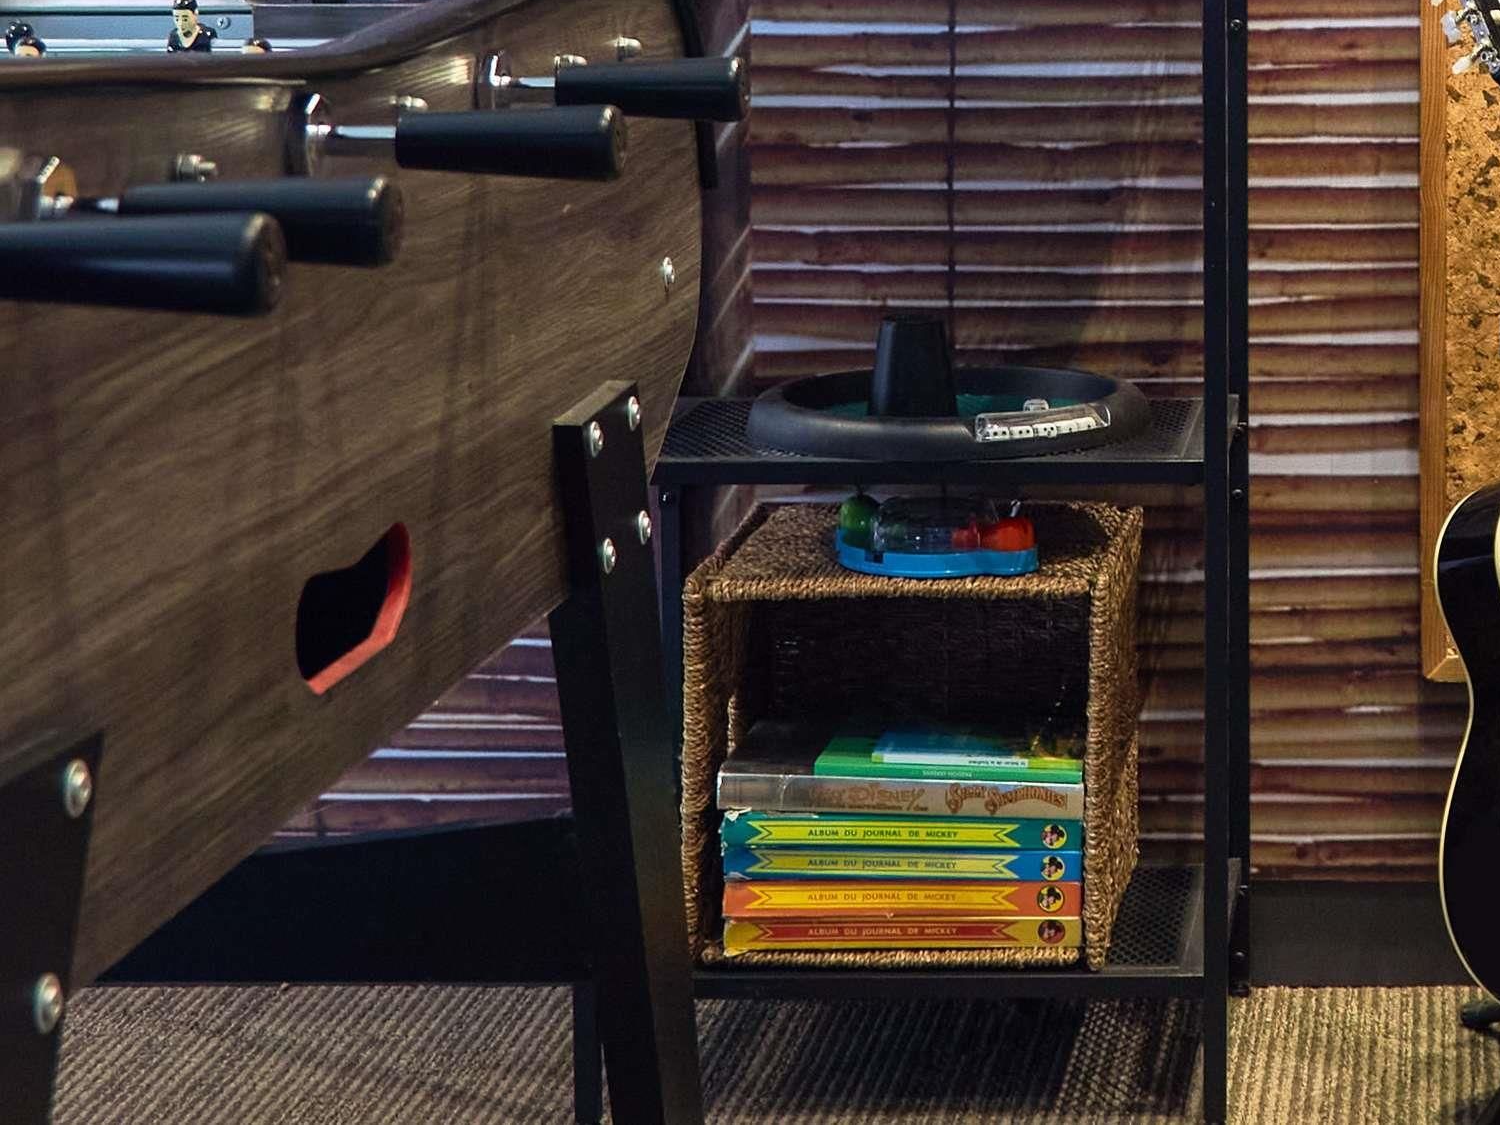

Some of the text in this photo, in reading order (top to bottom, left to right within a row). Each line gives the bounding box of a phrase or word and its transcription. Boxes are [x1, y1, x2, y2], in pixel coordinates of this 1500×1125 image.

[807, 828, 959, 838] ALBUM DU JOURNAL DE MICKEY
[807, 858, 957, 869] ALBUM DU JOURNAL DE MICKEY
[807, 892, 957, 902] ALBUM DU JOURNAL DE MICKEY
[807, 927, 958, 936] ALBUM DU JOURNAL DE MICKEY
